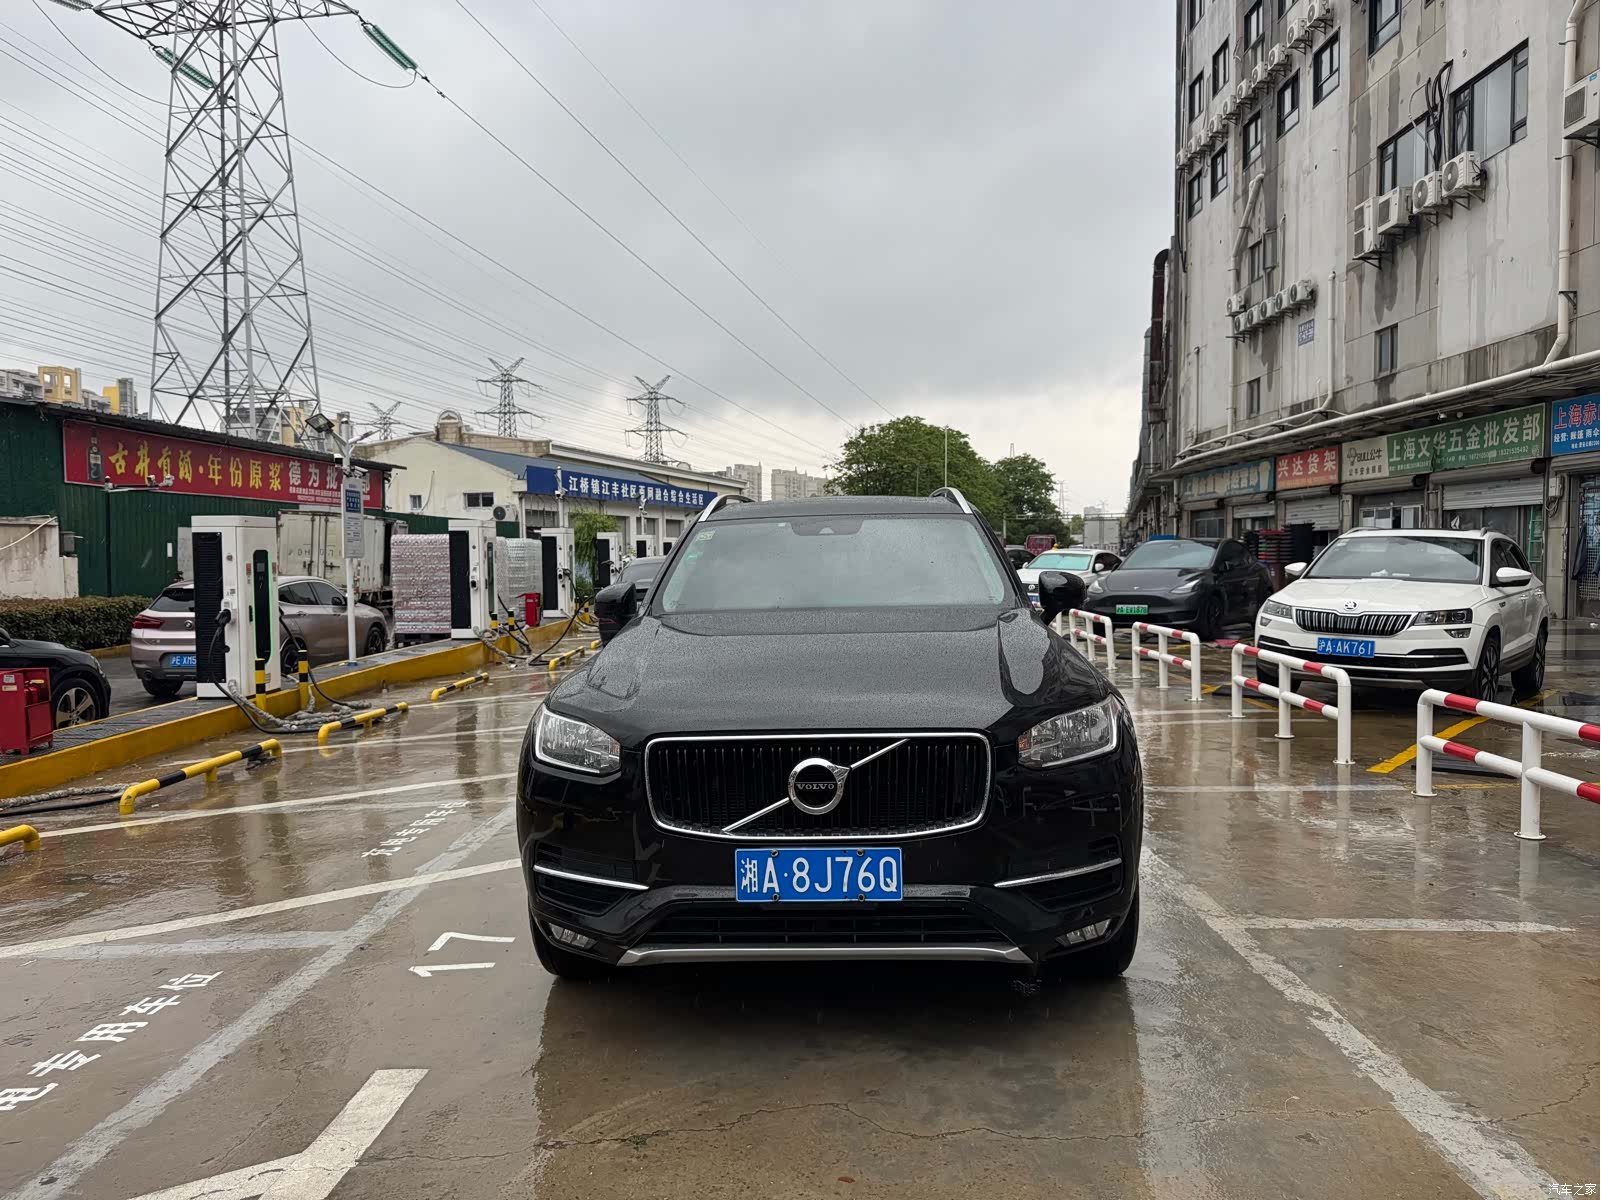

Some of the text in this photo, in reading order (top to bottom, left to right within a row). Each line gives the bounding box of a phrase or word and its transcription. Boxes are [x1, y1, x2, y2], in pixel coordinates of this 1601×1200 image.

[1554, 401, 1600, 429] 上海赤
[1389, 413, 1541, 462] 上海文华五金批发部
[289, 460, 370, 494] 德为批部
[1278, 450, 1336, 478] 兴达货架
[171, 655, 197, 665] 沪E·XM5
[1319, 639, 1372, 656] 沪A·AK761
[796, 783, 835, 791] VOLVO
[740, 856, 898, 893] 湘A·8J76Q
[408, 931, 516, 977] 17
